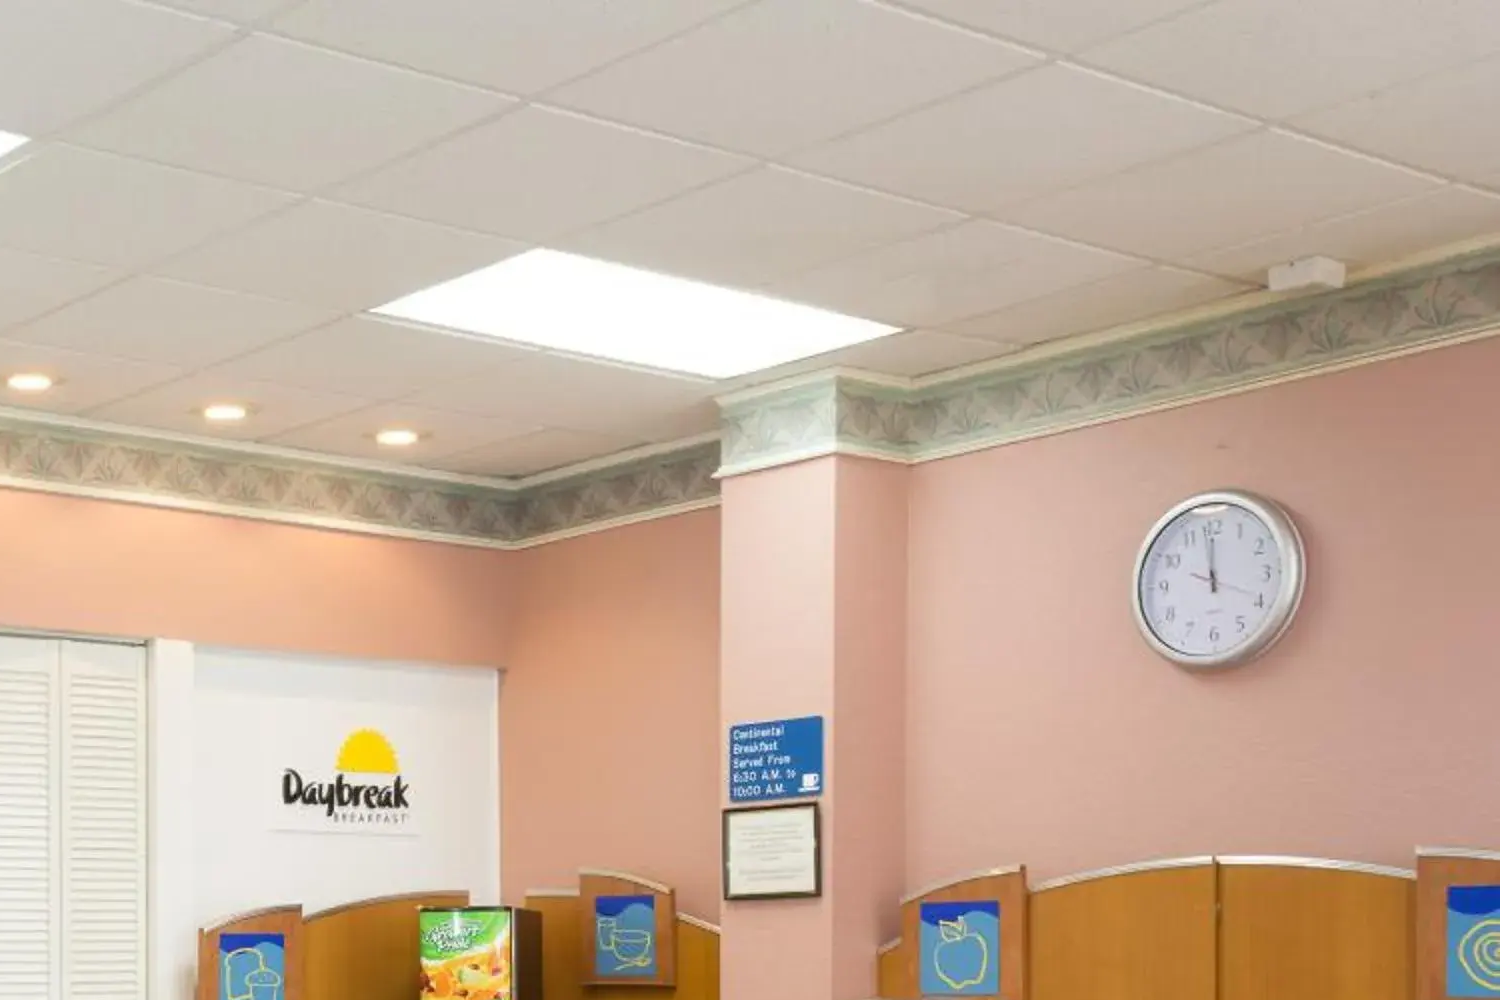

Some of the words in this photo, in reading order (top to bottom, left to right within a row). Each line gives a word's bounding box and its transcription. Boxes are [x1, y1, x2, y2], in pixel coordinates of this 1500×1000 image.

[1184, 529, 1196, 548] 11
[1237, 523, 1244, 540] 1
[1253, 538, 1266, 556] 2
[1165, 553, 1181, 569] 10
[1260, 563, 1272, 582] 3
[1159, 579, 1170, 594] 9
[1253, 592, 1265, 609] 4
[1165, 606, 1176, 622] 8
[1185, 620, 1196, 638] 7
[1235, 615, 1246, 633] 5
[1209, 626, 1221, 642] 6
[733, 724, 785, 741] Continental
[733, 741, 779, 755] Breakfast
[733, 756, 763, 769] Served
[767, 754, 791, 766] From
[733, 770, 757, 783] 6:30
[283, 767, 409, 817] Daybreak
[334, 811, 406, 824] BREAKFAST
